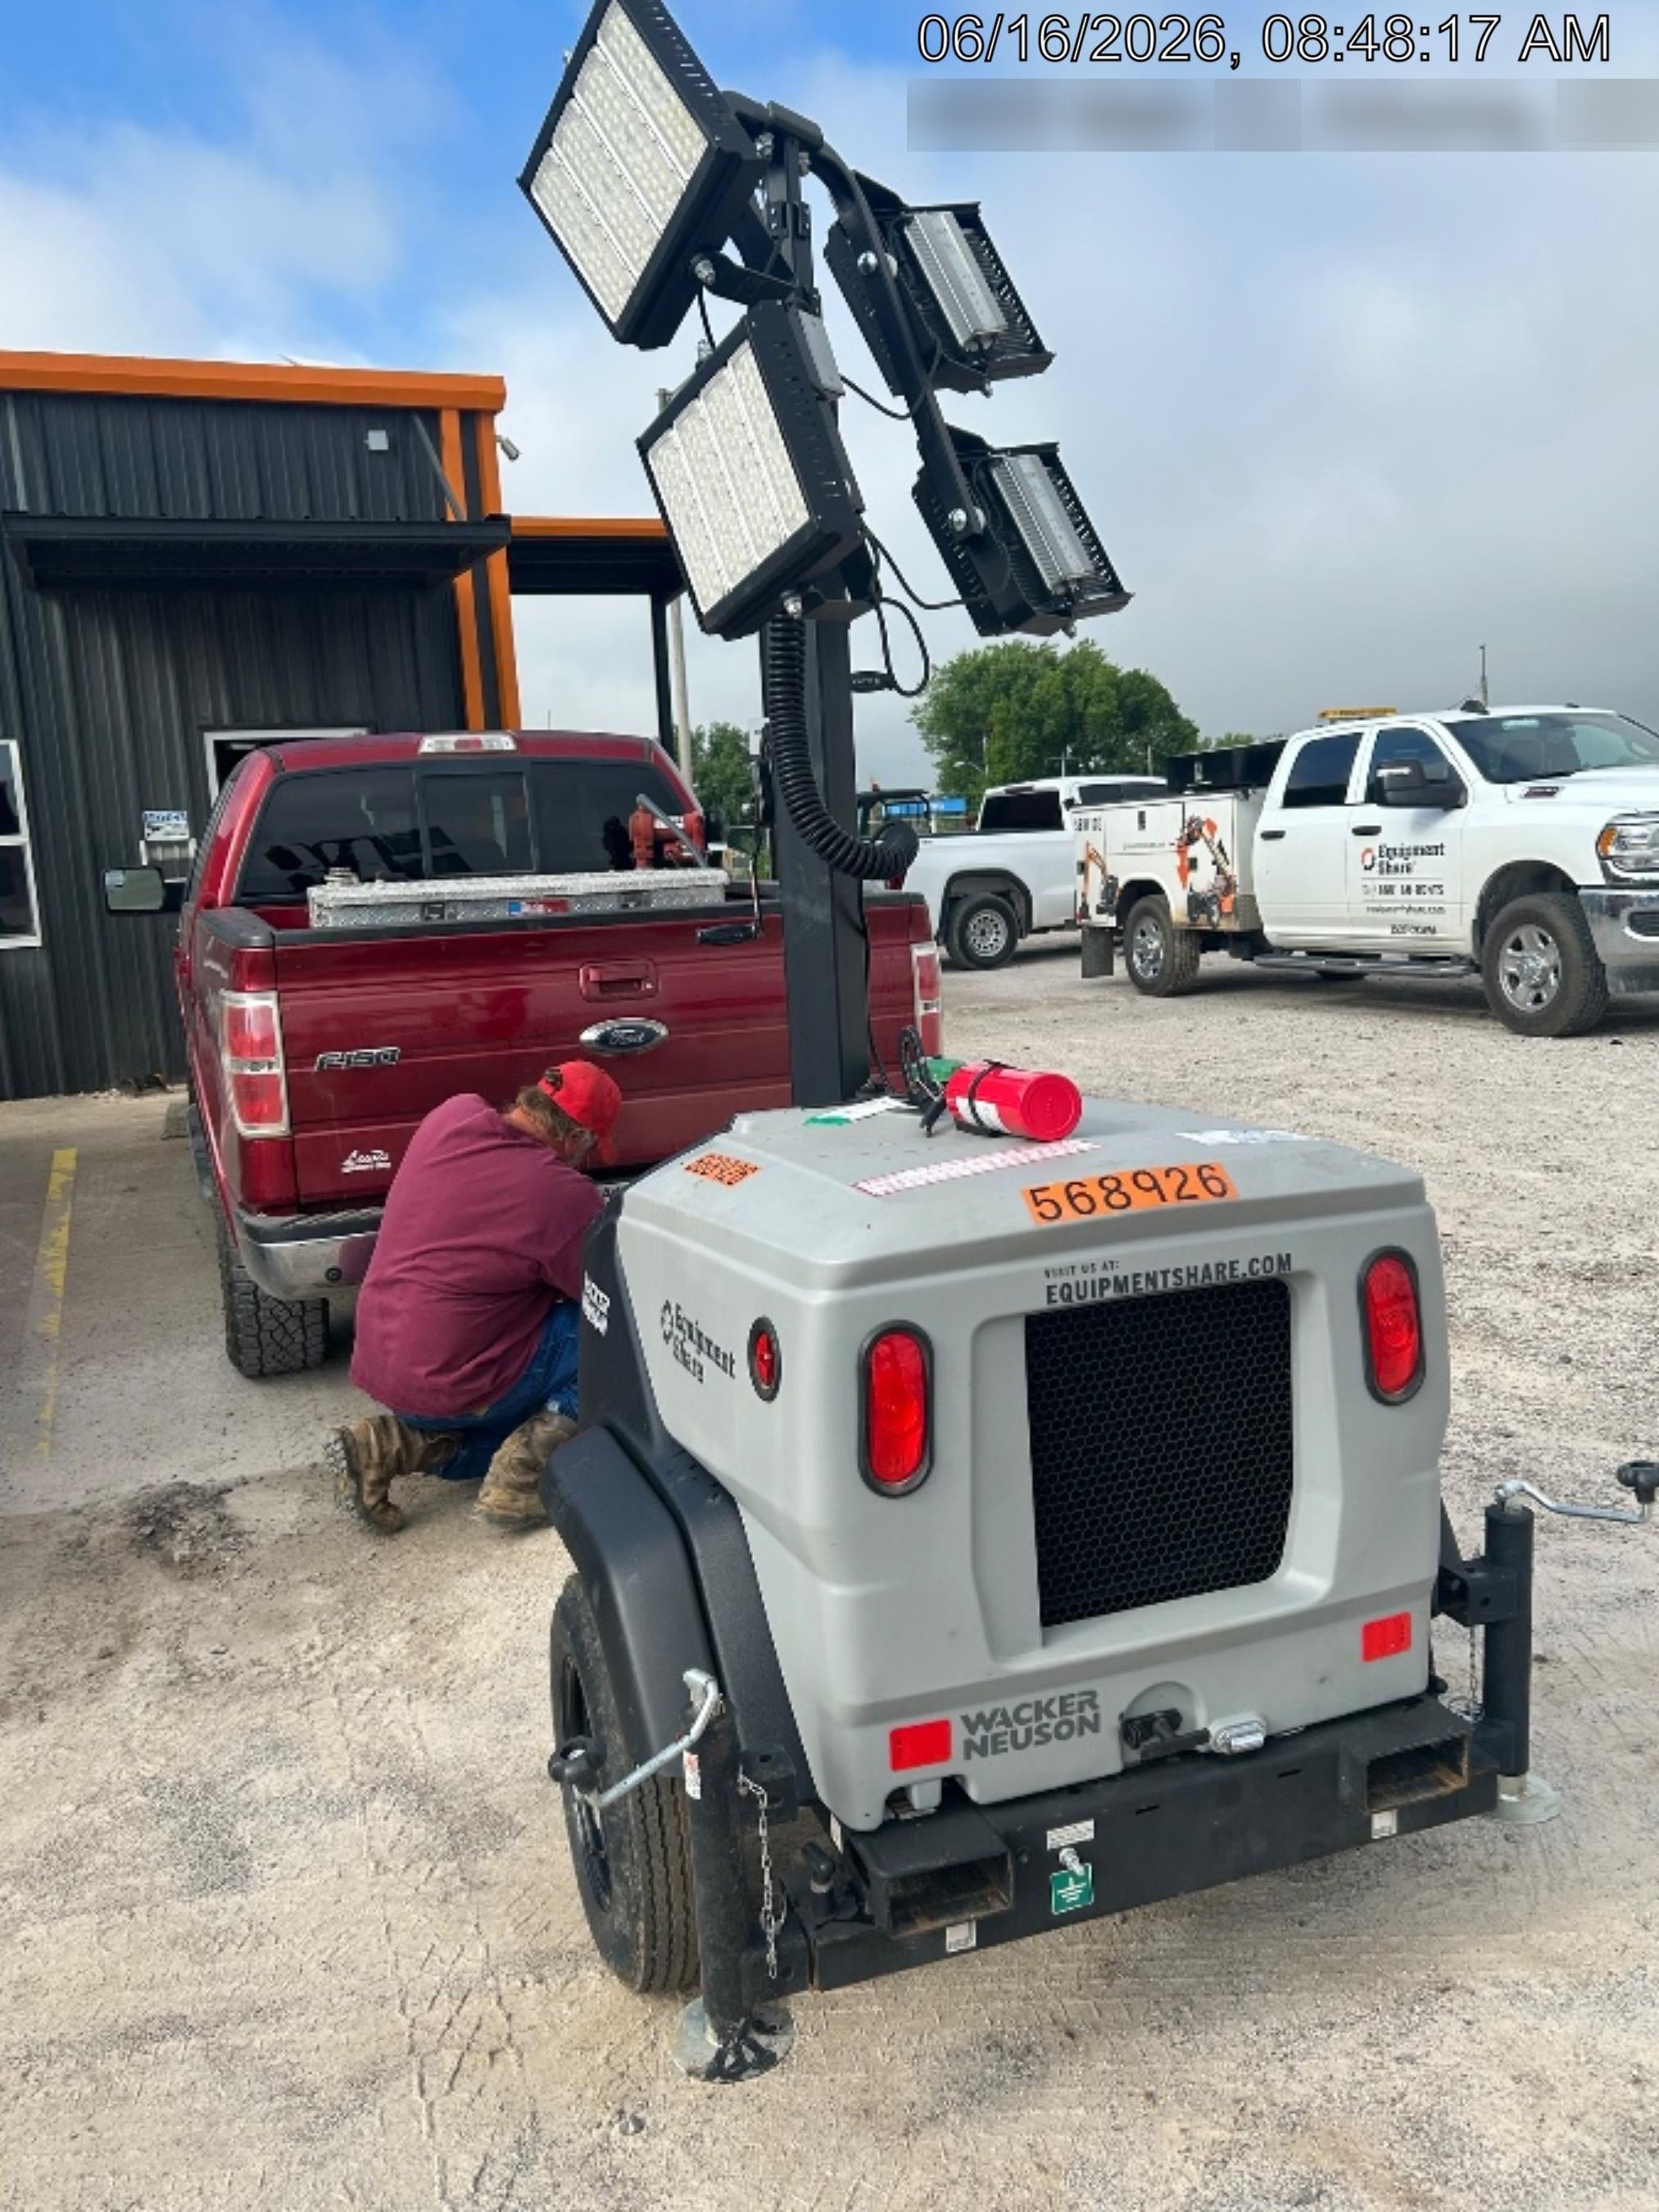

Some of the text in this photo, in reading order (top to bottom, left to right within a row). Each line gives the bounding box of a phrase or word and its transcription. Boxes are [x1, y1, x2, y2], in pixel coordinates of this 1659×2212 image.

[1378, 842, 1444, 861] Equipment
[1029, 1164, 1228, 1221] 568926
[1045, 1252, 1292, 1306] EQUIPMENTSHARE.COM
[1081, 1262, 1097, 1274] US
[960, 1689, 1100, 1737] WACKER
[963, 1712, 1100, 1761] NEUSON
